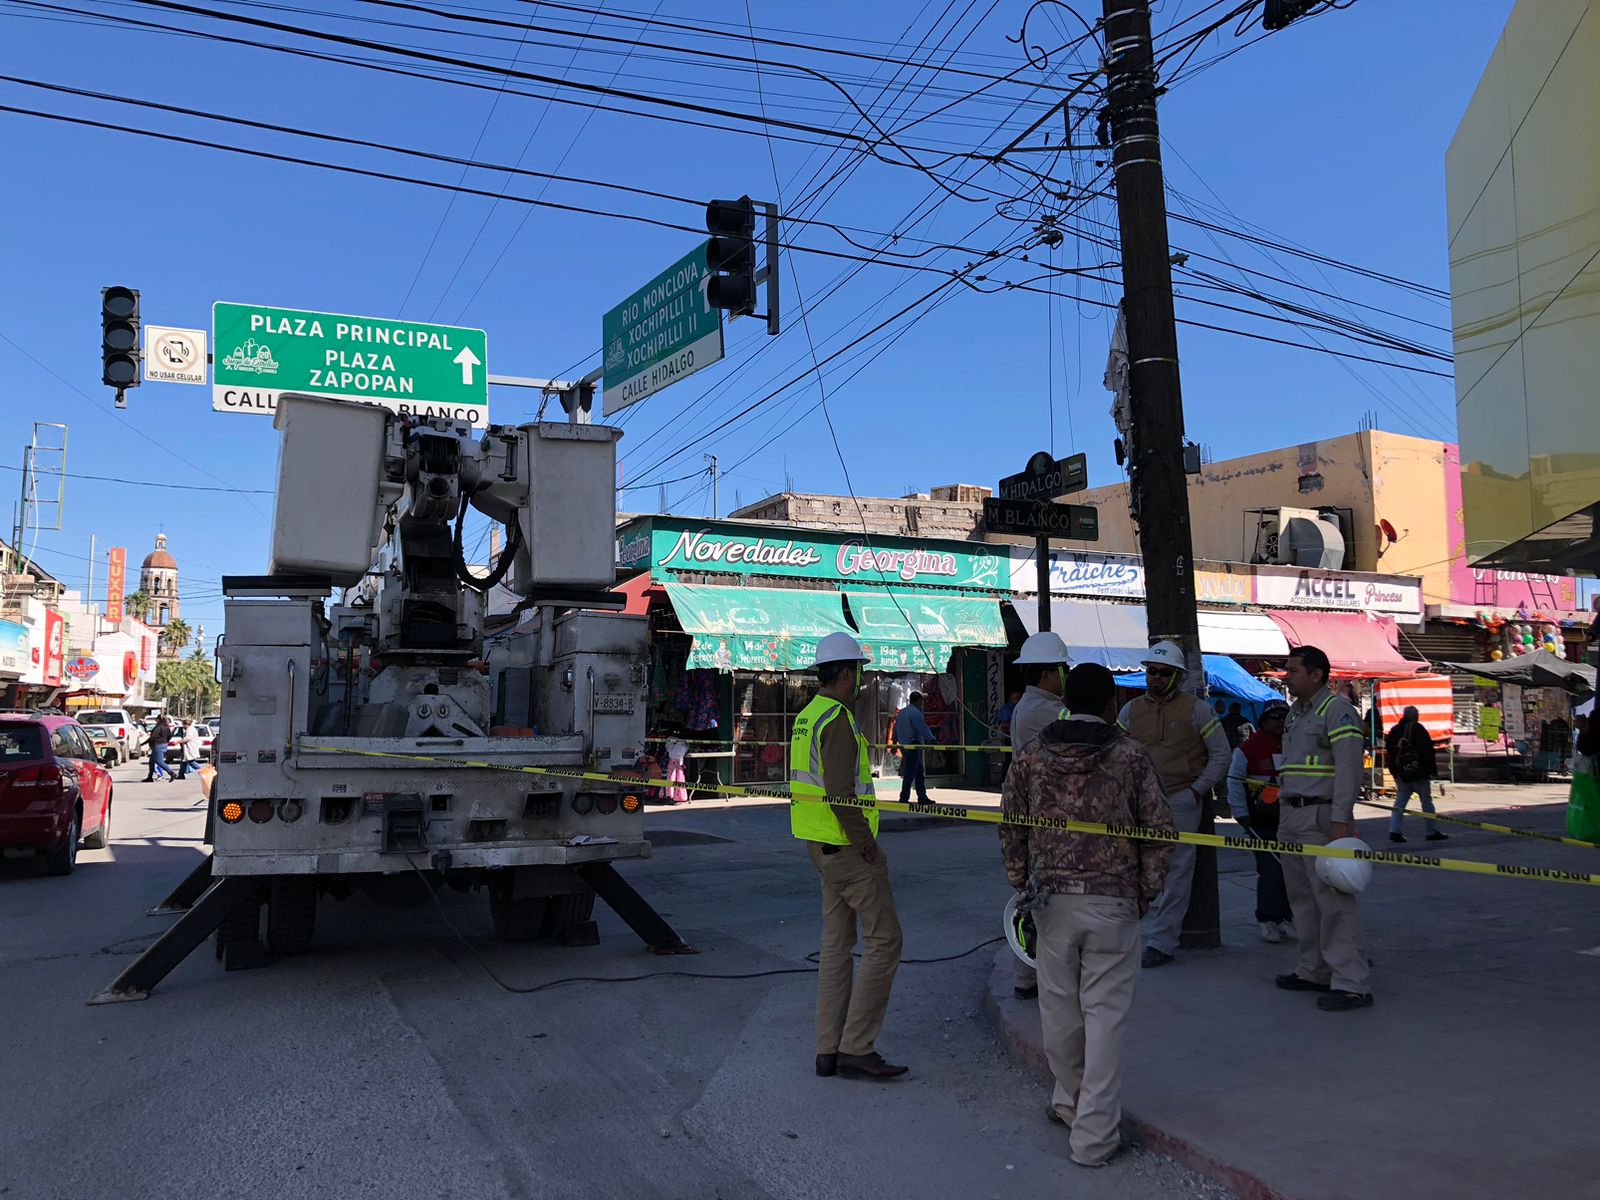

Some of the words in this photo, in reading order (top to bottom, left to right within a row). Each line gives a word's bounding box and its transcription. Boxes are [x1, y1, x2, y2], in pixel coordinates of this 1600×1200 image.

[622, 301, 639, 327] RÍO
[643, 261, 698, 313] MONCLOVA
[250, 313, 324, 339] PLAZA
[336, 323, 453, 351] PRINCIPAL
[628, 295, 684, 346] XOCHIPILLI
[627, 321, 683, 369] XOCHIPILLI
[688, 313, 697, 334] II
[325, 348, 396, 372] PLAZA
[149, 370, 159, 378] NO
[160, 371, 175, 379] USAR
[176, 372, 202, 381] CELULAR
[309, 369, 414, 394] ZAPOPAN
[622, 375, 648, 401] CALLE
[651, 350, 695, 391] HIDALGO
[224, 390, 277, 409] CALL
[1005, 509, 1069, 530] BLANCO
[658, 526, 822, 567] Novedades
[835, 537, 958, 581] Georgina
[109, 550, 122, 620] LUXOR
[1364, 583, 1403, 606] Princess
[1289, 596, 1321, 606] ACCESORIOS
[1322, 598, 1335, 606] PARA
[1336, 598, 1361, 608] CELULARES
[744, 640, 754, 650] 14
[754, 642, 764, 651] de
[800, 643, 810, 654] 21
[880, 645, 888, 656] 19
[796, 656, 816, 665] Marz
